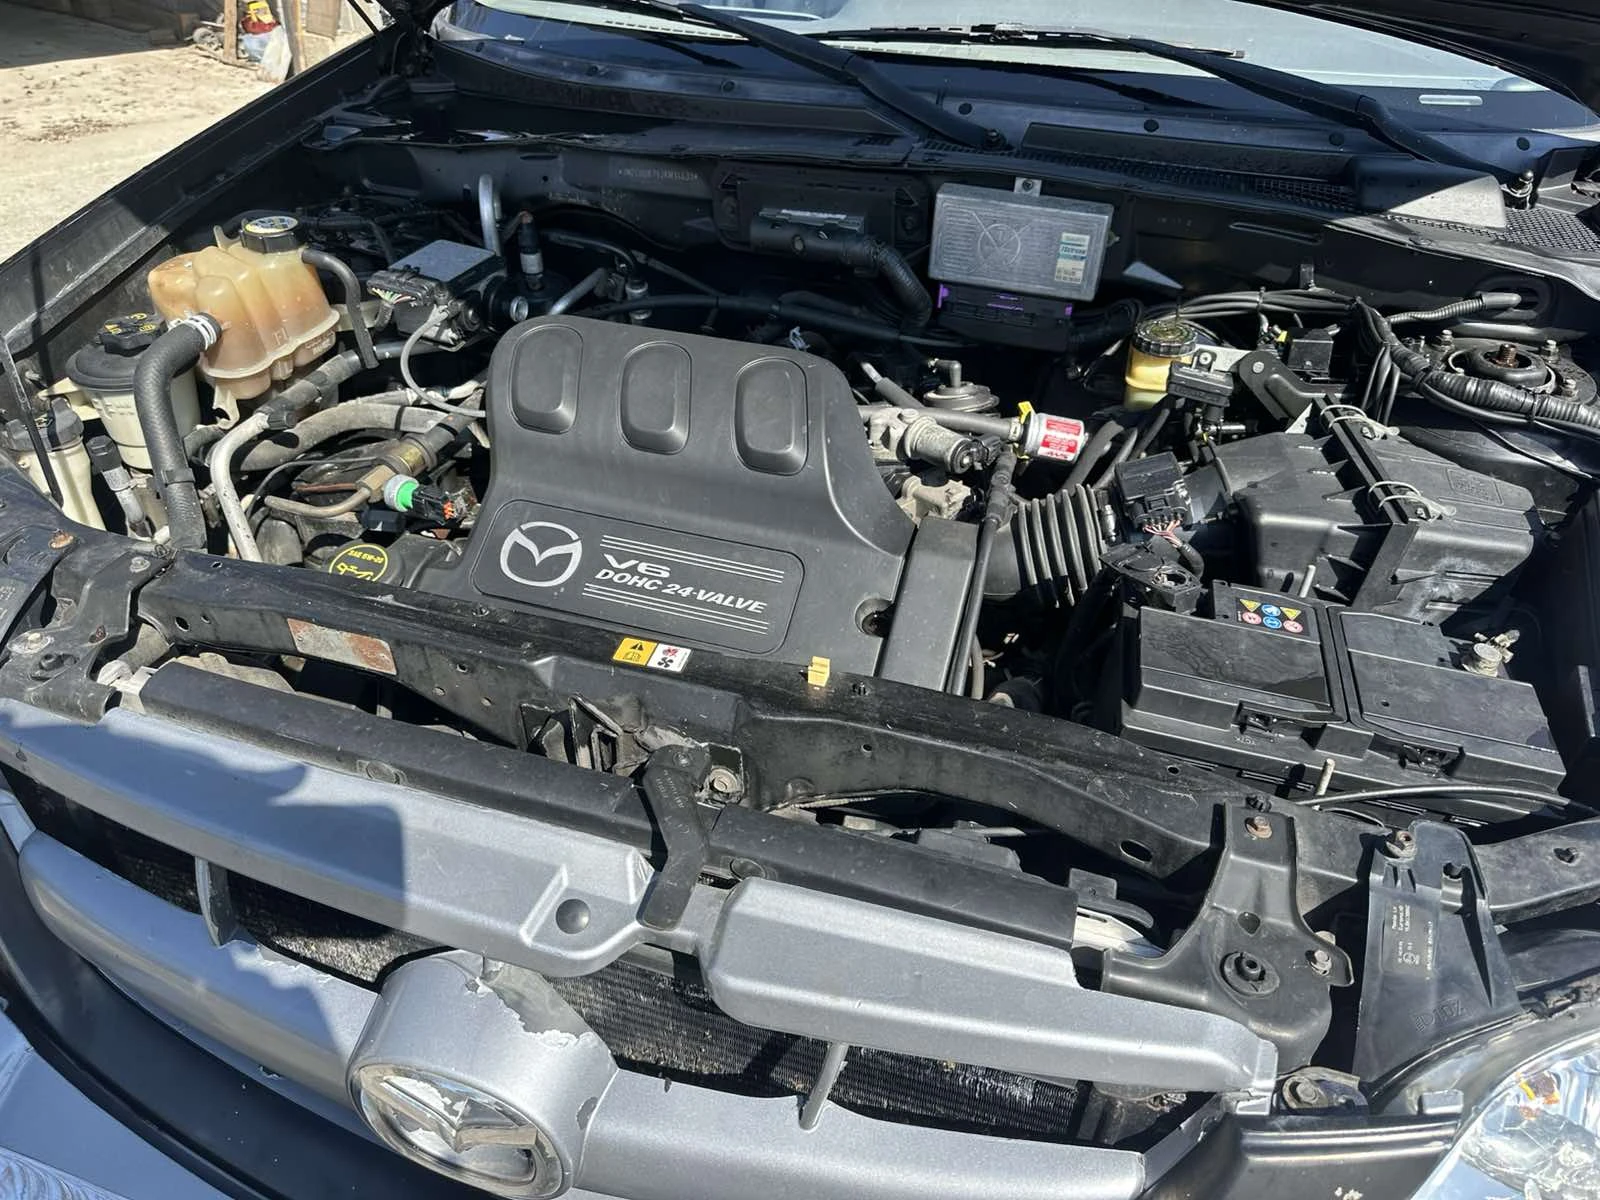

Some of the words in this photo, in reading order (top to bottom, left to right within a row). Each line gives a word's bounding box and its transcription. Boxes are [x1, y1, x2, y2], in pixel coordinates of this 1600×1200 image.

[603, 553, 671, 578] V6
[595, 568, 663, 590] DOHC
[661, 583, 768, 613] 24-VALVE
